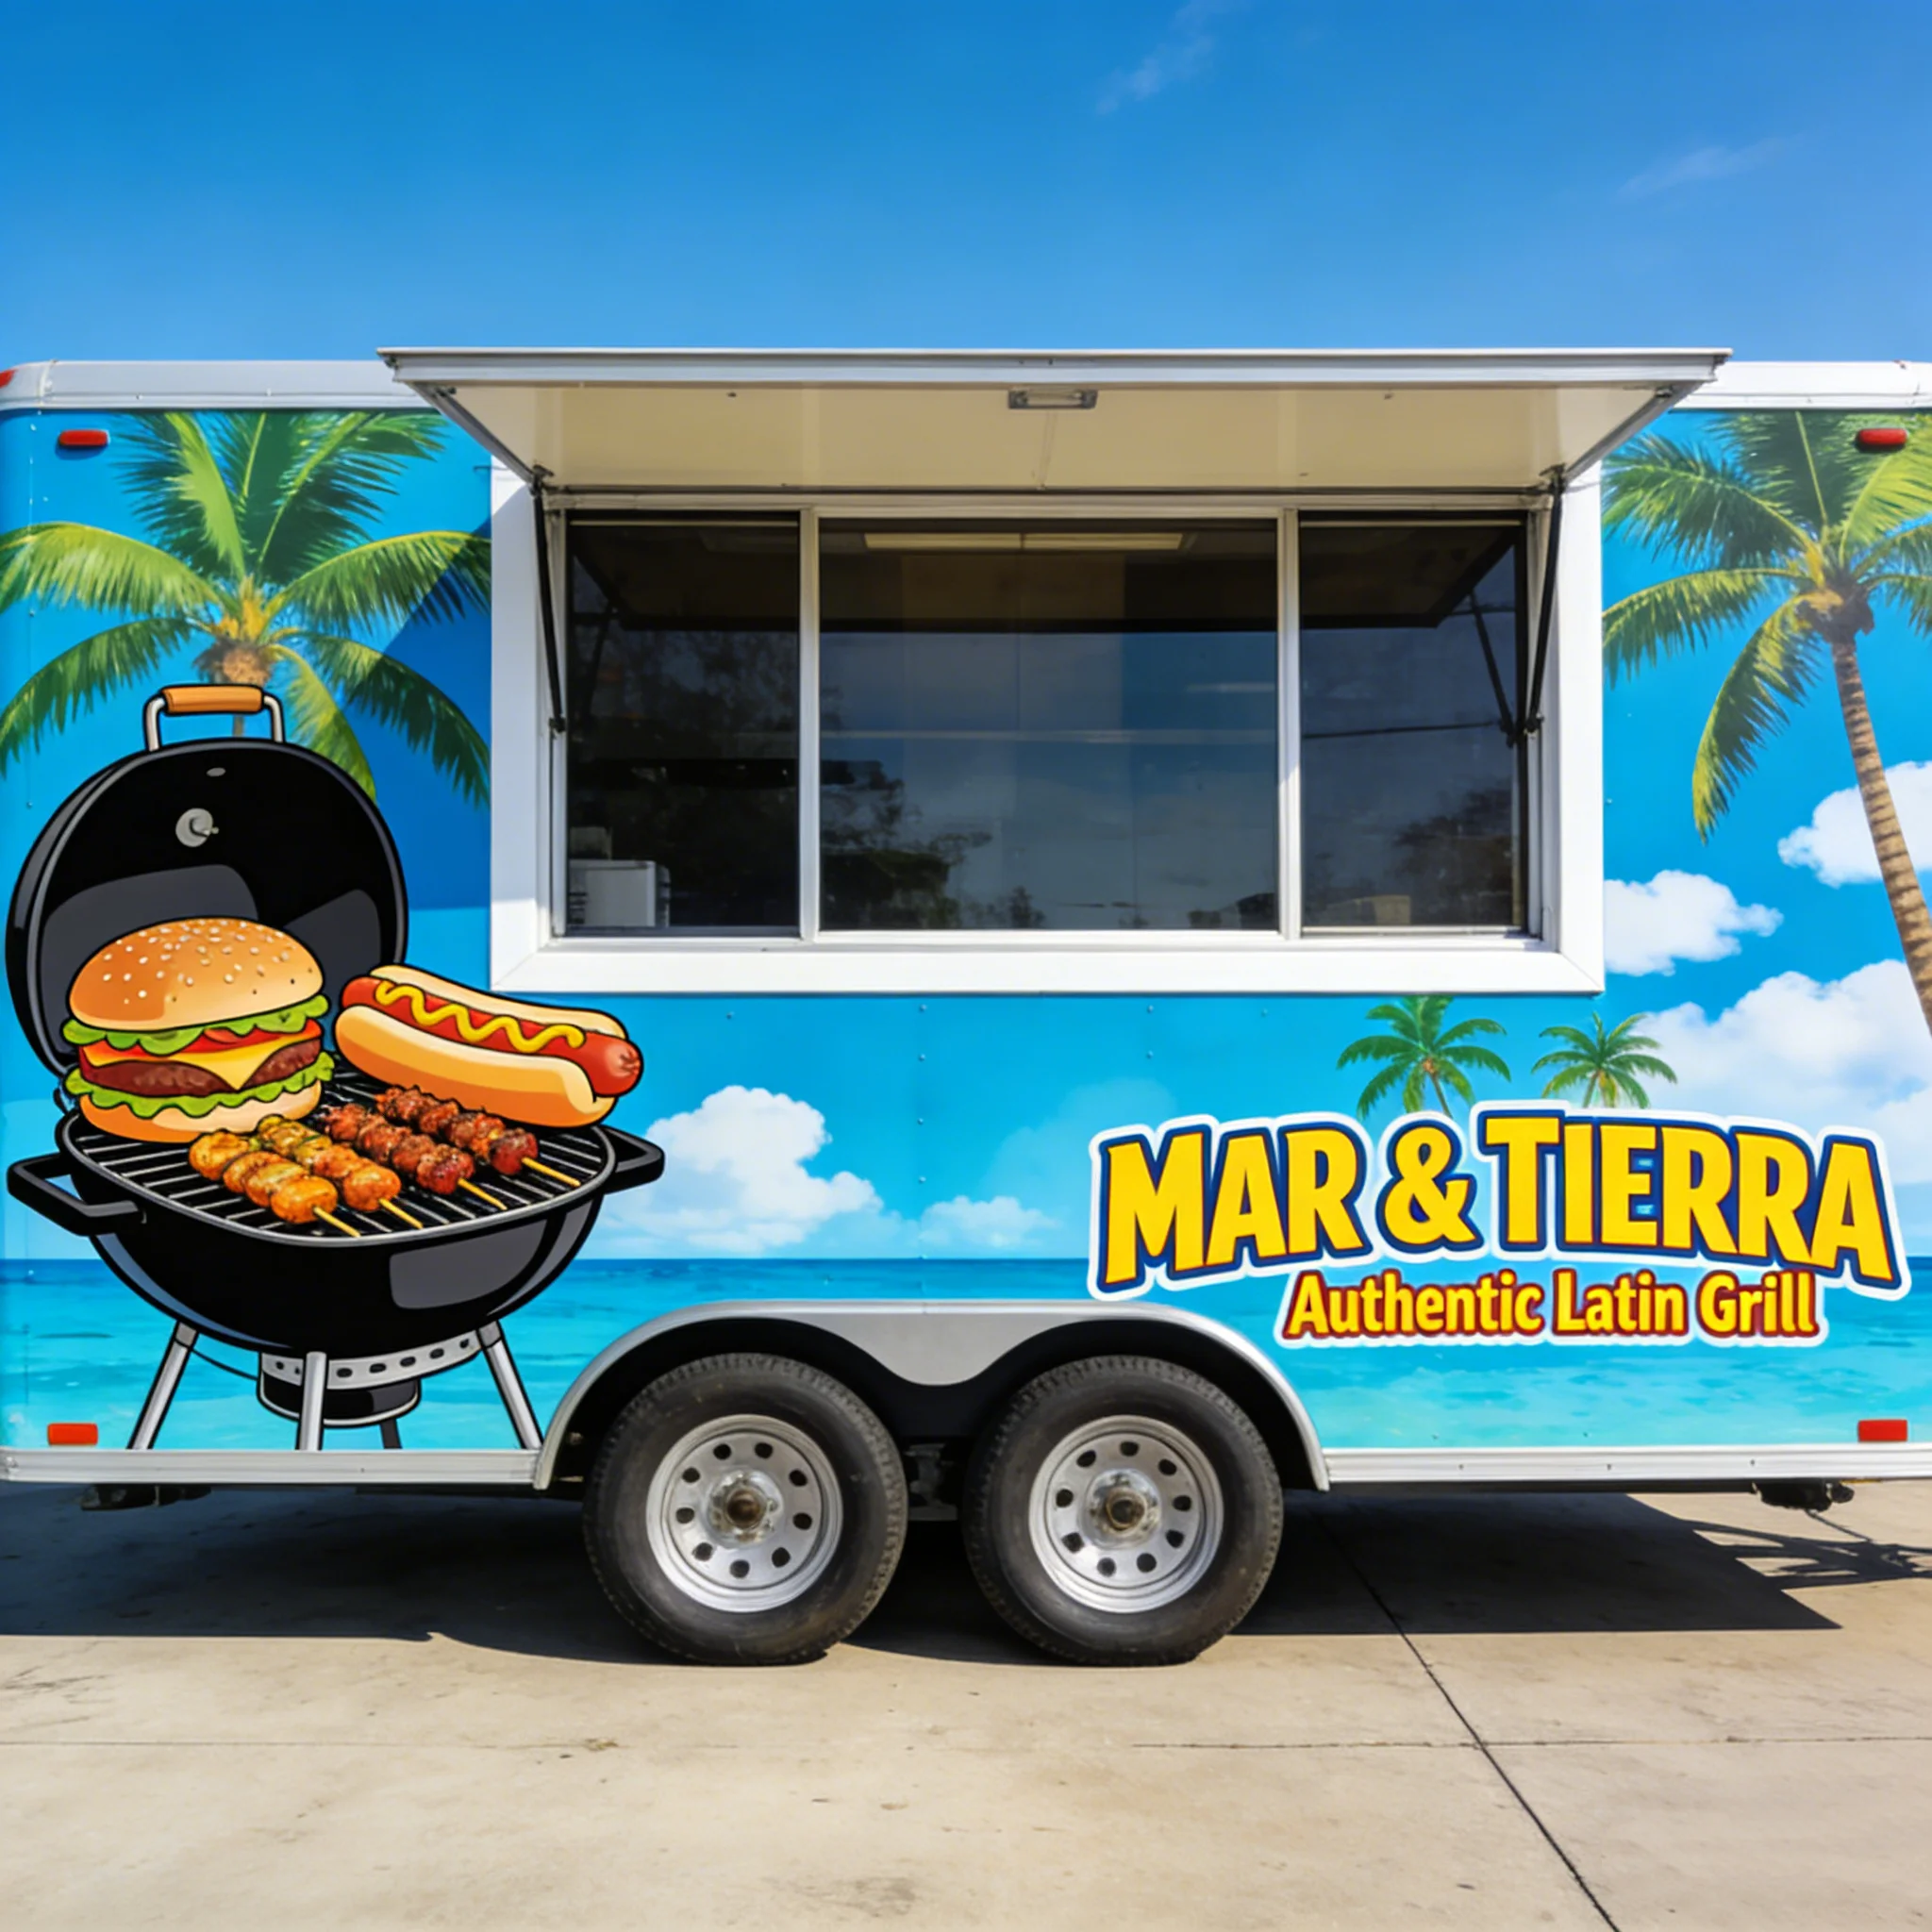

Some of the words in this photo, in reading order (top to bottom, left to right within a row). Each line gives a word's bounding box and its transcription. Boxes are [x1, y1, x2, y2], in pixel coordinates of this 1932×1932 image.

[1102, 1124, 1367, 1287] MAR
[1381, 1124, 1479, 1248] &
[1482, 1114, 1896, 1284] TIERRA
[1286, 1271, 1544, 1337] Authentic
[1556, 1270, 1687, 1335] Latin
[1698, 1271, 1817, 1336] Grill
